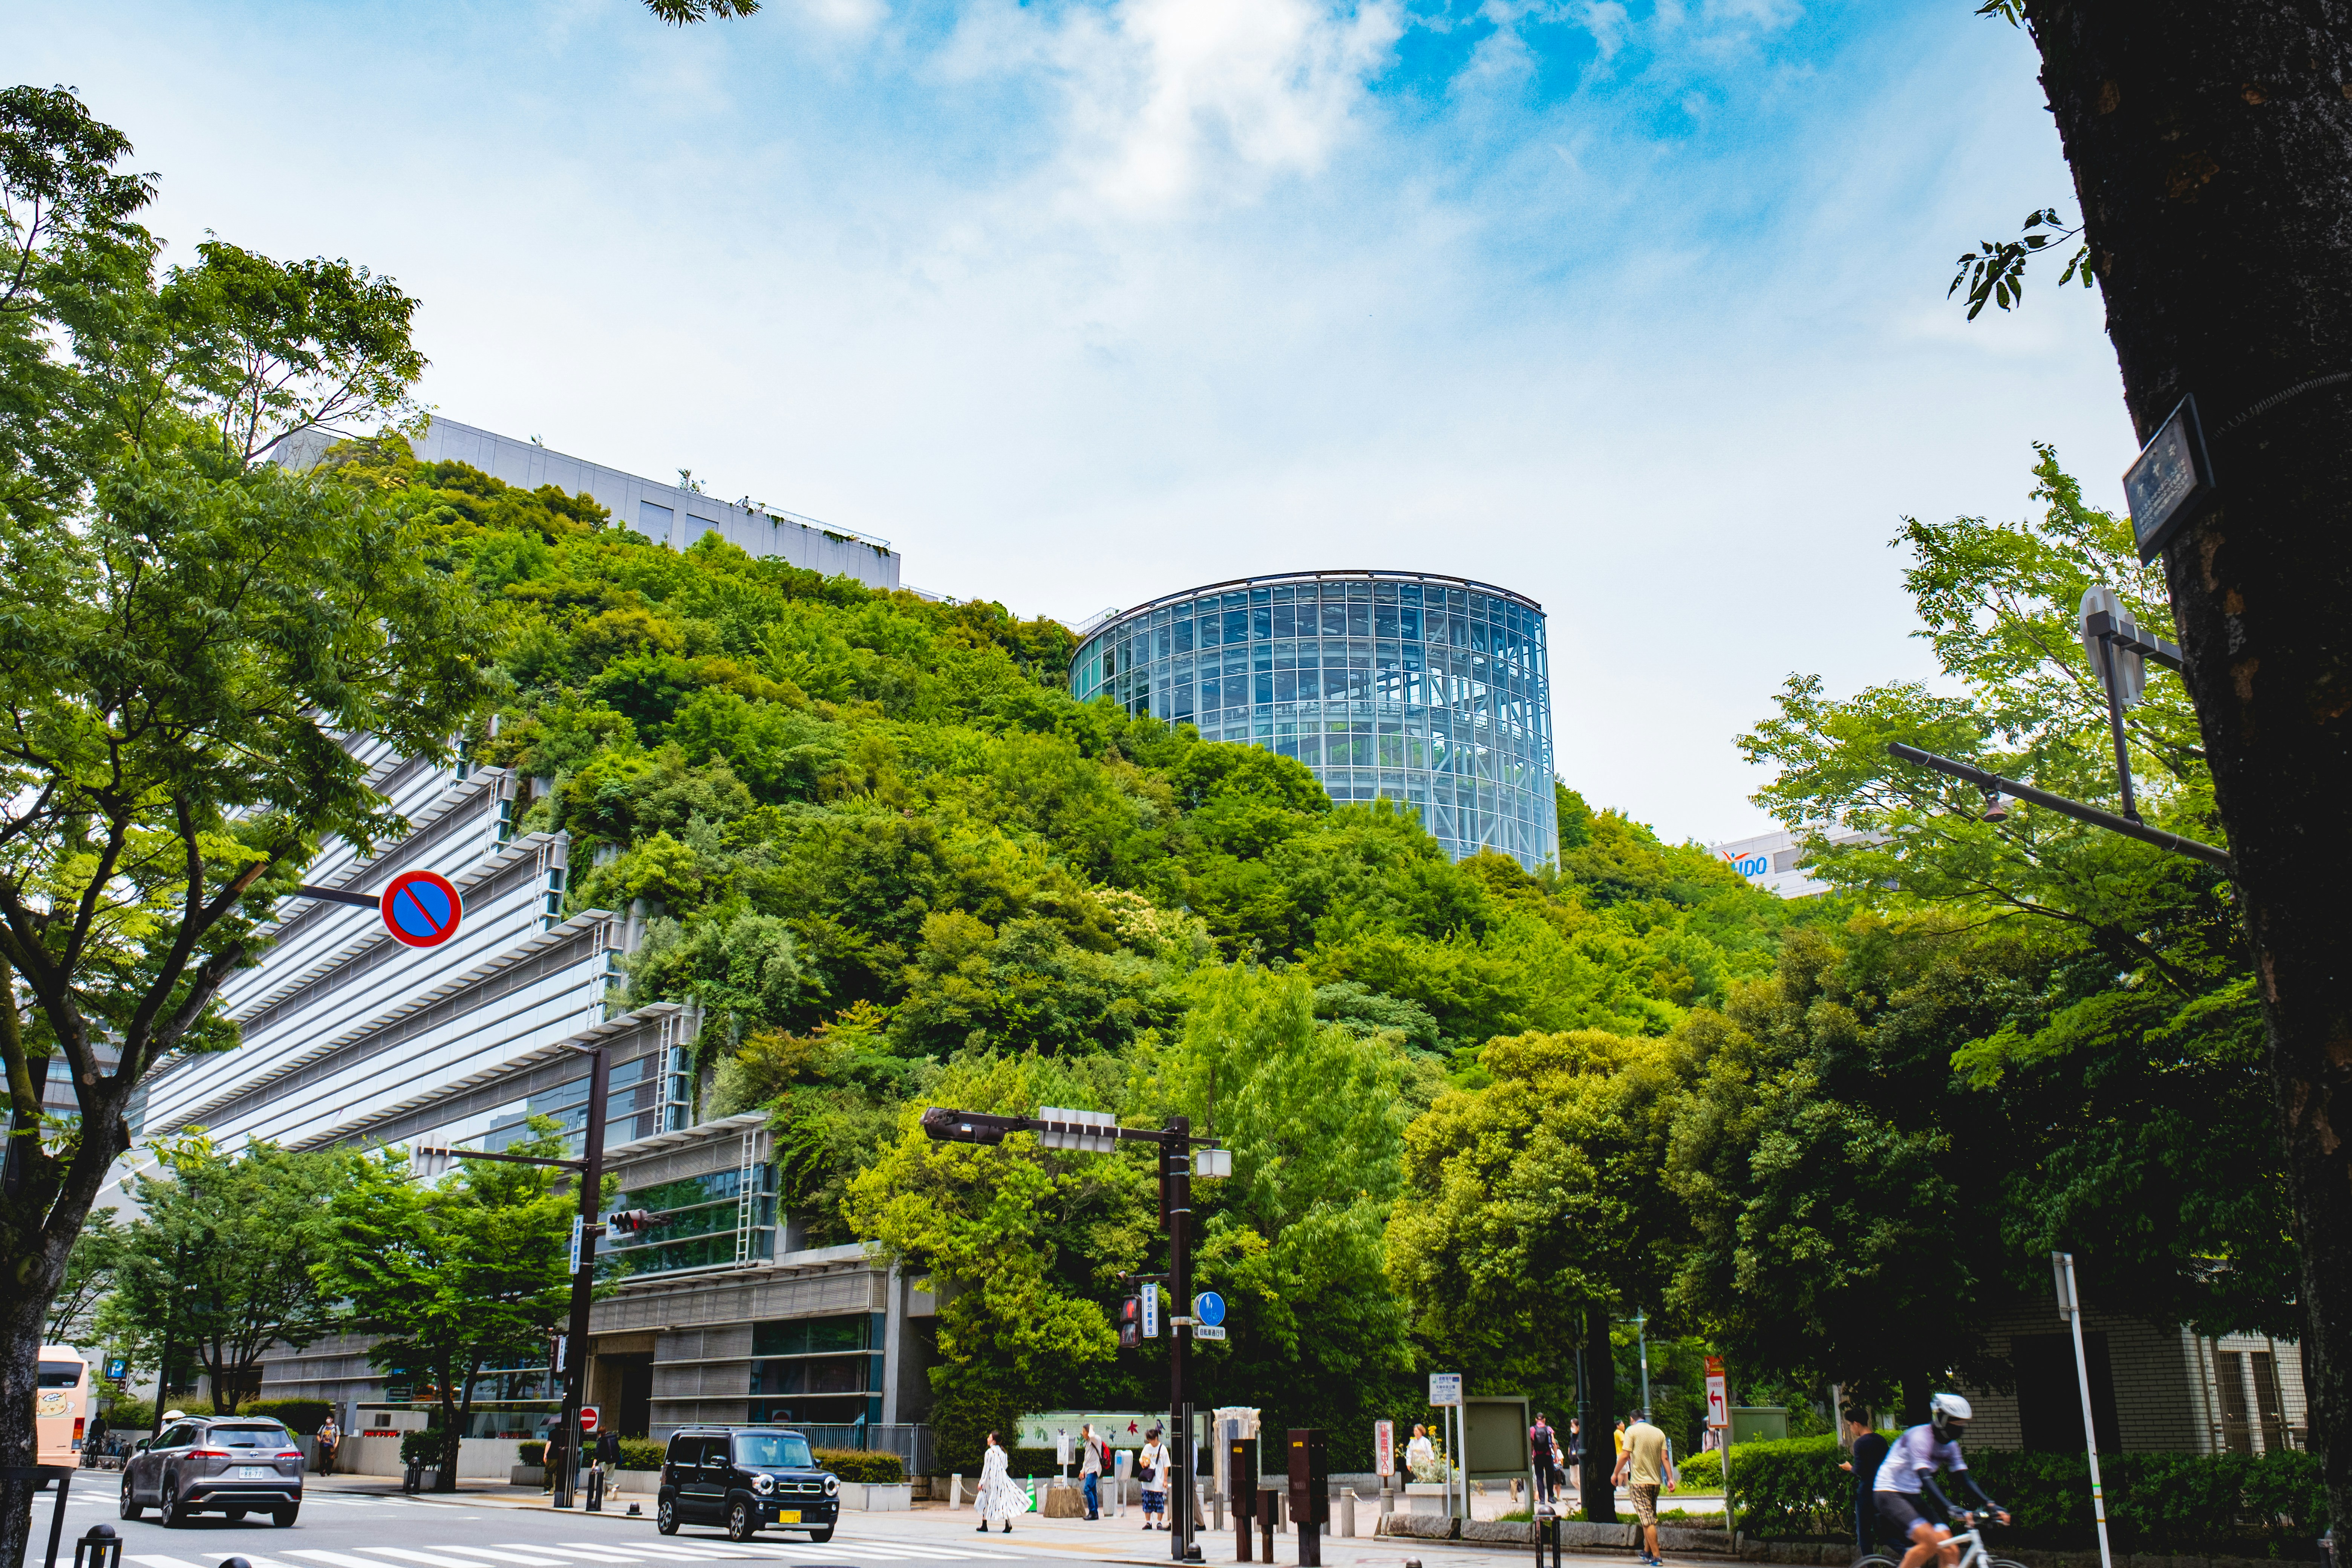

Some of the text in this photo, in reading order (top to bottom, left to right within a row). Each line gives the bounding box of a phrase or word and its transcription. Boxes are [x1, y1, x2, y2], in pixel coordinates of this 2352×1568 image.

[1200, 1328, 1223, 1337] 自転車通行可
[111, 1362, 123, 1375] P
